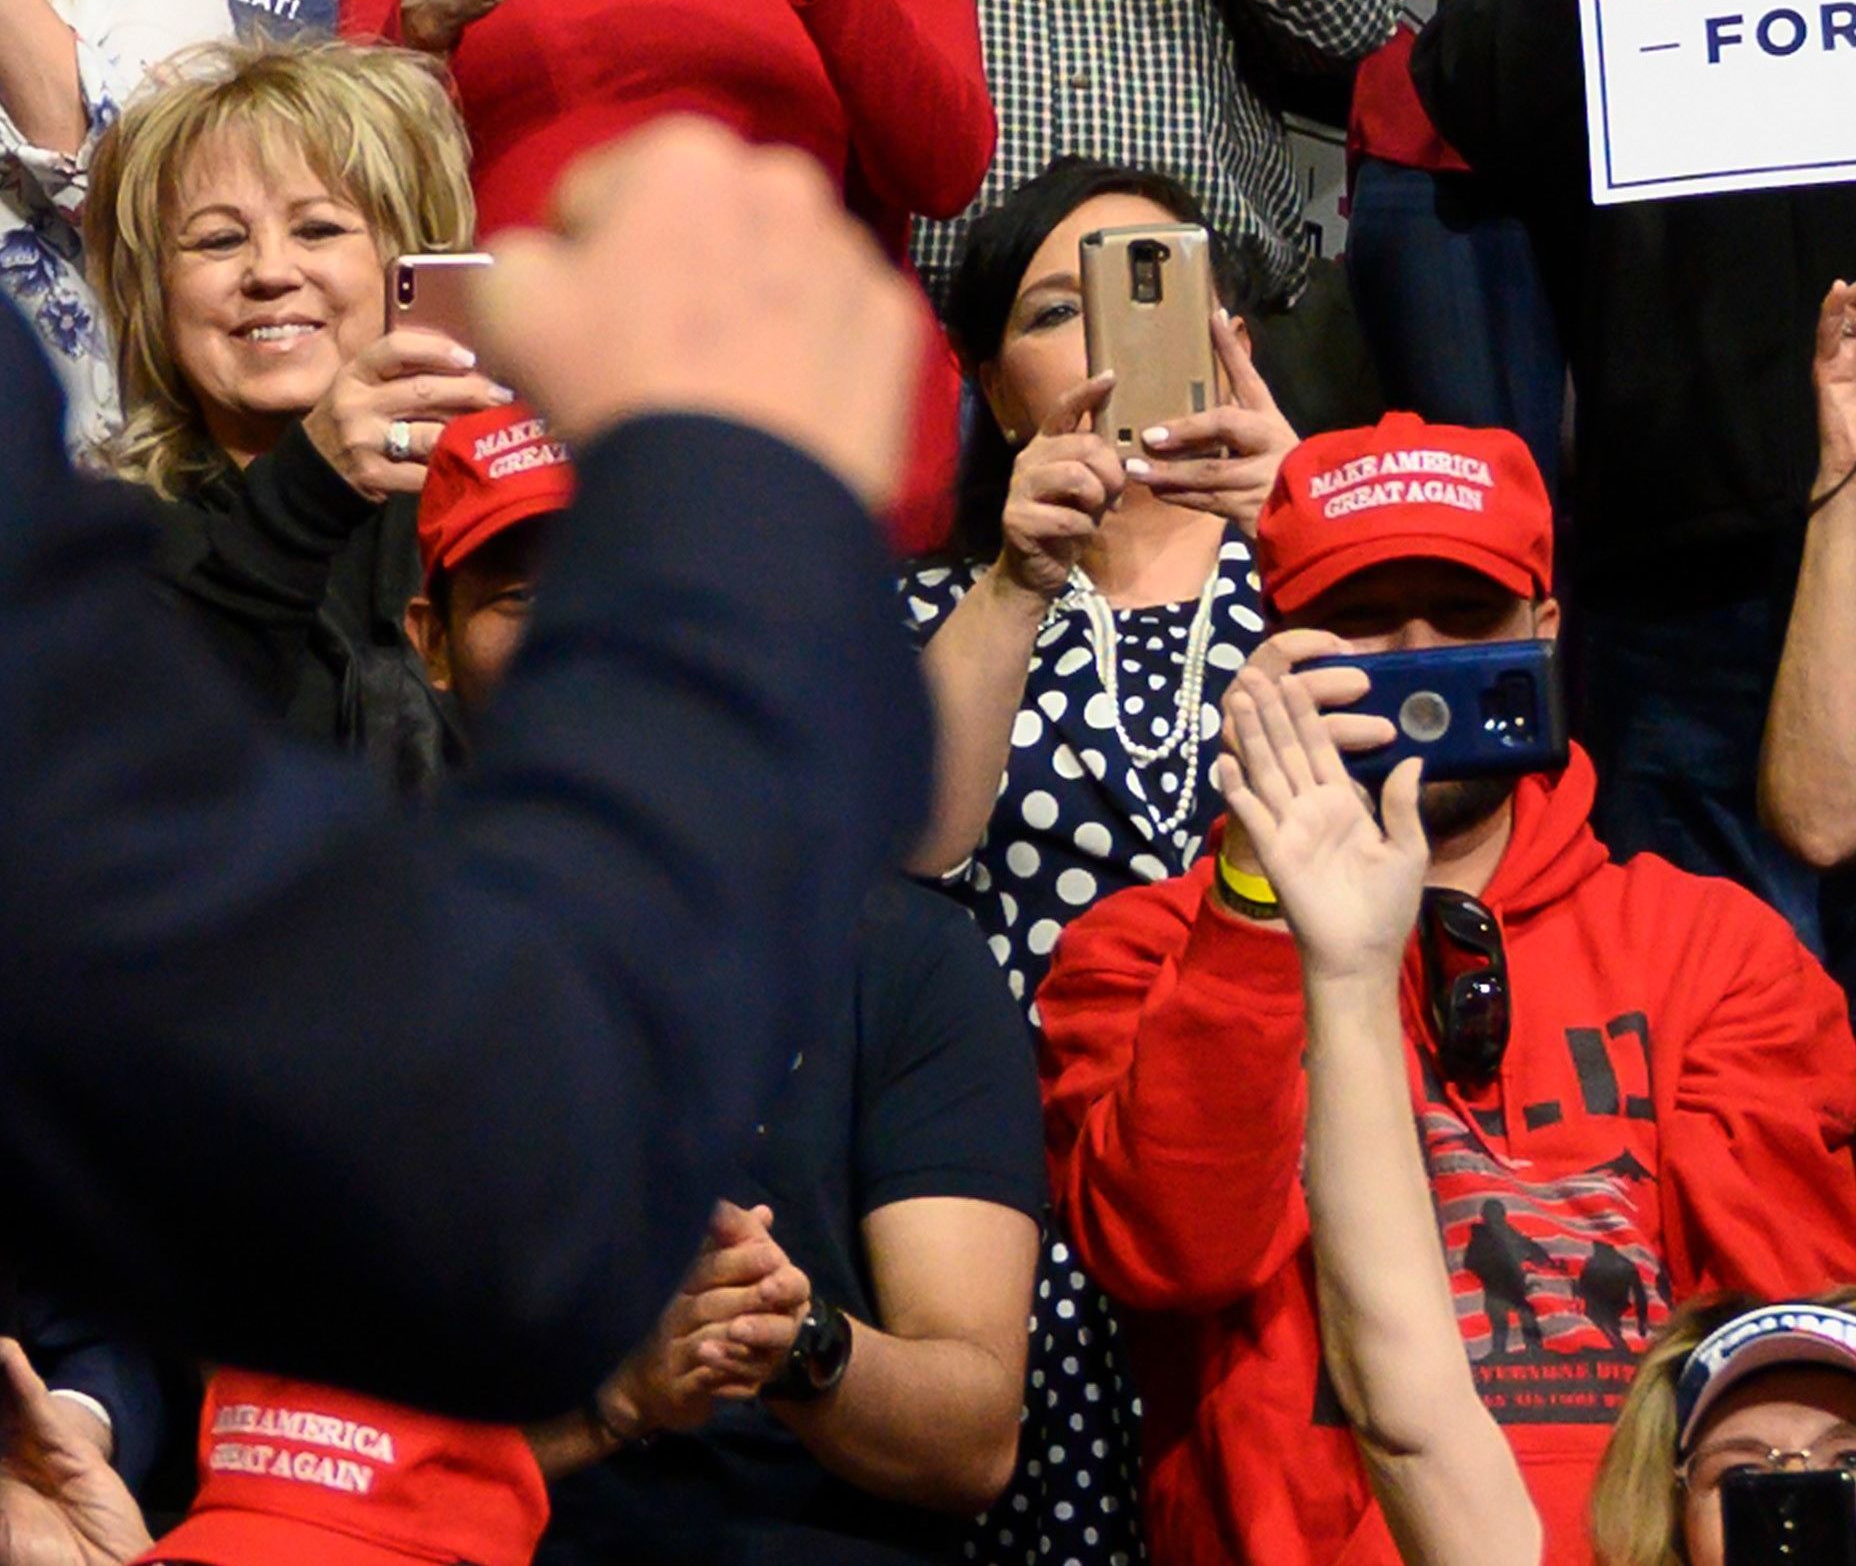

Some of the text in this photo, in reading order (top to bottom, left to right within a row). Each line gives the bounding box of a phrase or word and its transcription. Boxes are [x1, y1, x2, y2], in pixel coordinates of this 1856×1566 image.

[1704, 1, 1856, 65] FOR
[1309, 449, 1495, 499] MAKE AMERICA
[1324, 480, 1484, 520] GREAT AGAIN
[258, 1408, 396, 1464] AMERICA
[269, 1449, 375, 1494] AGAIN
